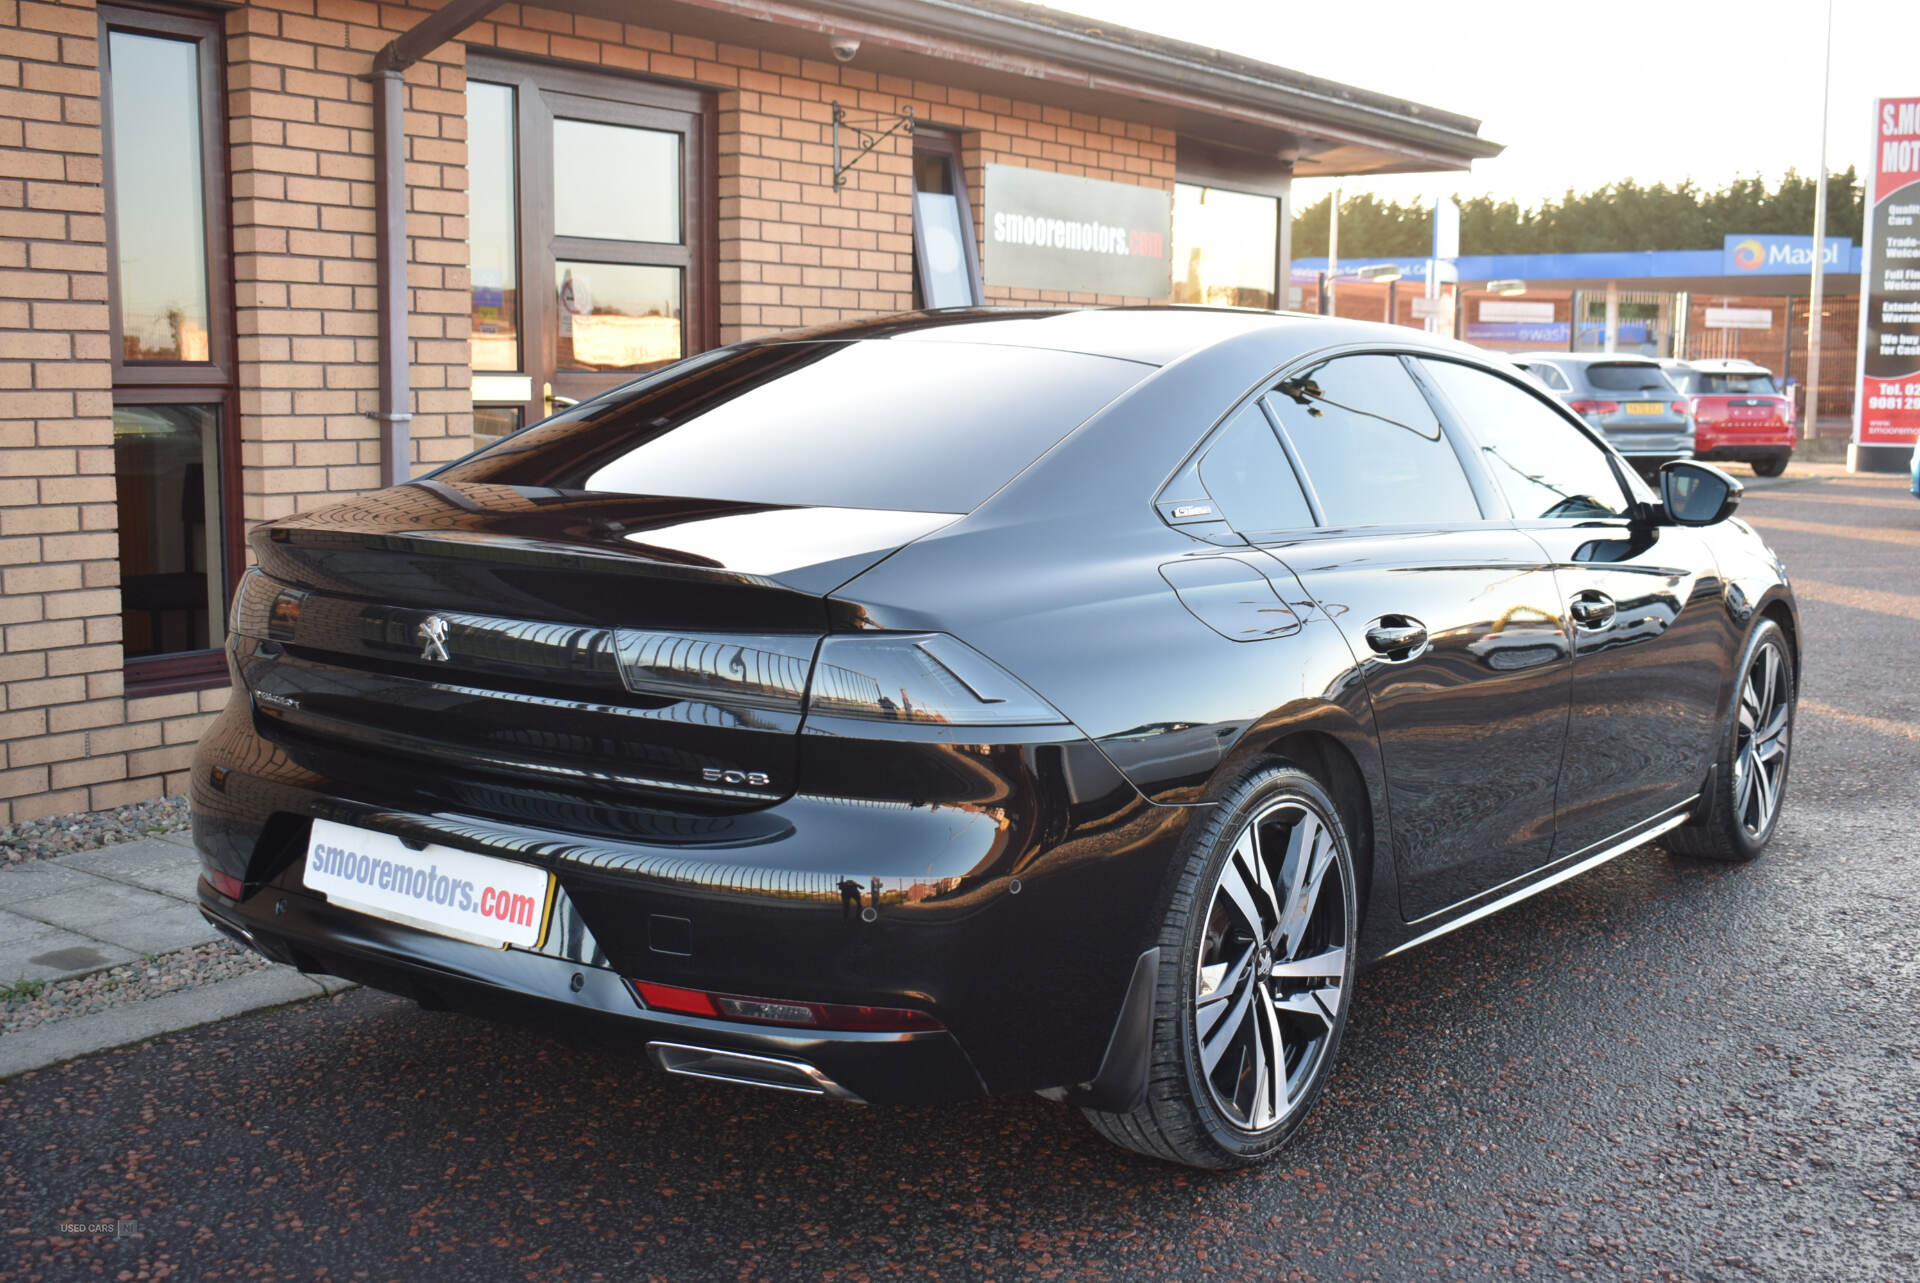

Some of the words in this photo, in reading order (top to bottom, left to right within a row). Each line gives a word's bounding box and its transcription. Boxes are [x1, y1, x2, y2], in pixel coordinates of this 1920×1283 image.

[994, 211, 1164, 259] smooremotors.com
[1880, 333, 1898, 345] We
[702, 767, 770, 786] 508
[312, 843, 535, 928] smooremotors.com
